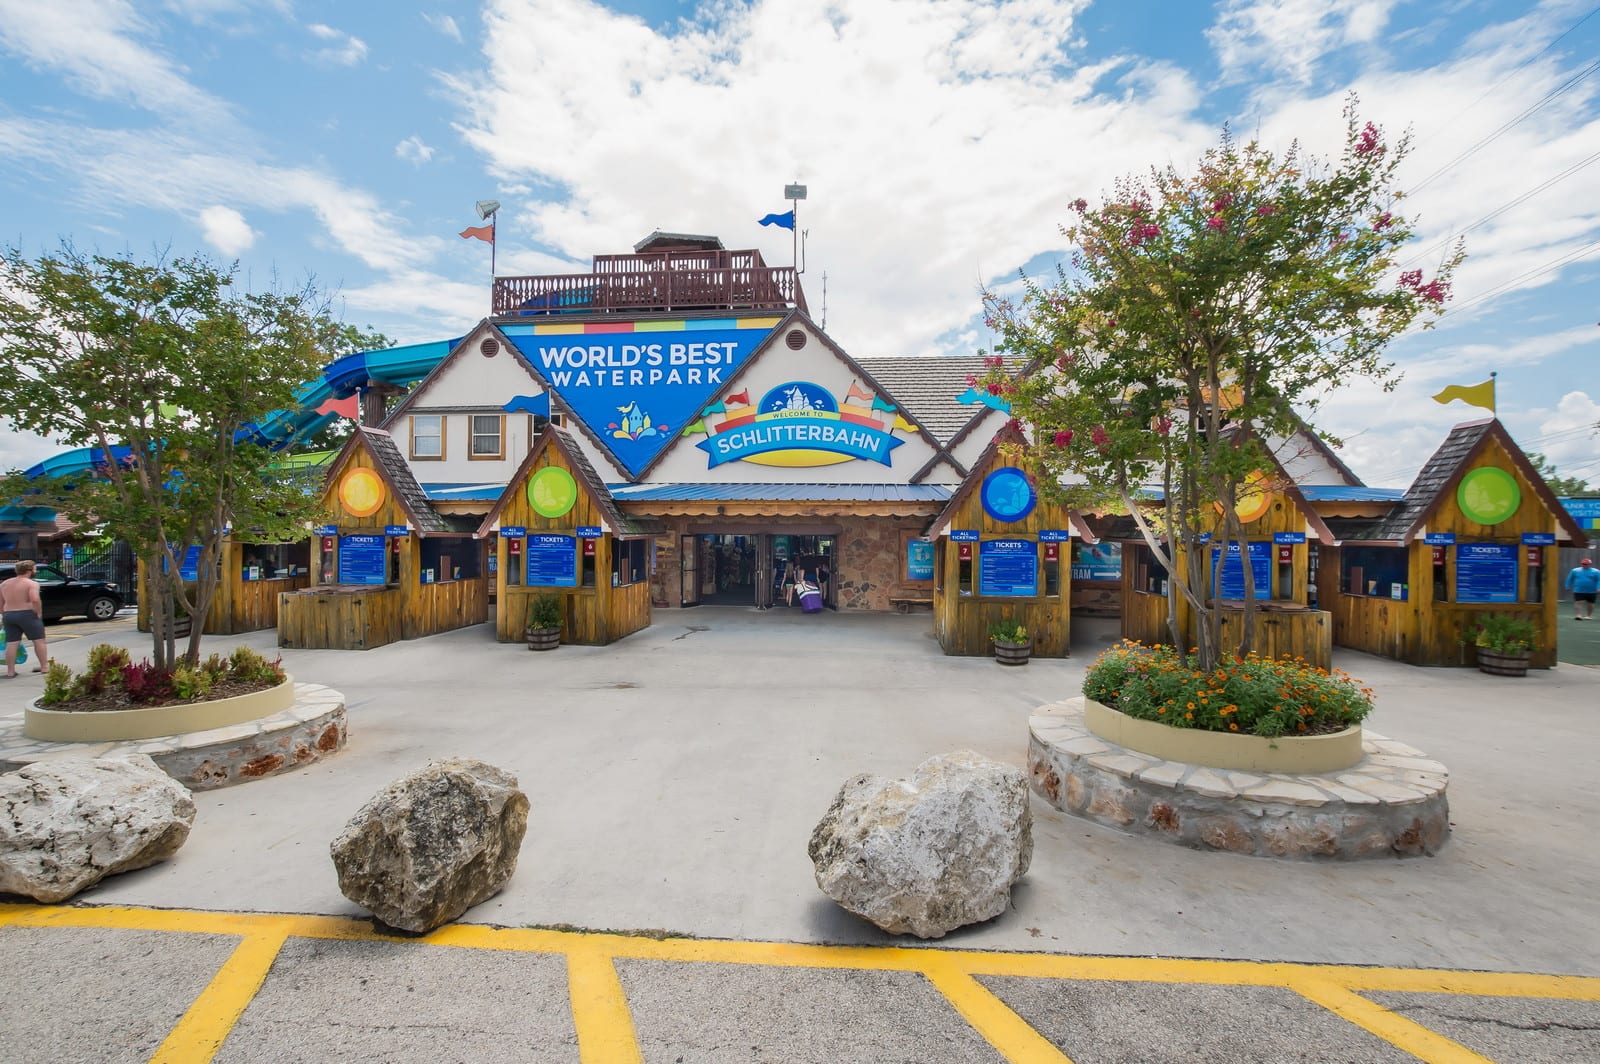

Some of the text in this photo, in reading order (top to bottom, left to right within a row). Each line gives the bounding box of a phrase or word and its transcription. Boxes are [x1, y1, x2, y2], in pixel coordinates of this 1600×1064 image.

[539, 342, 738, 369] WORLD'S BEST
[551, 368, 722, 387] WATERPARK
[773, 411, 824, 420] WELCOME TO
[717, 425, 880, 453] SCHLITTERBAHN
